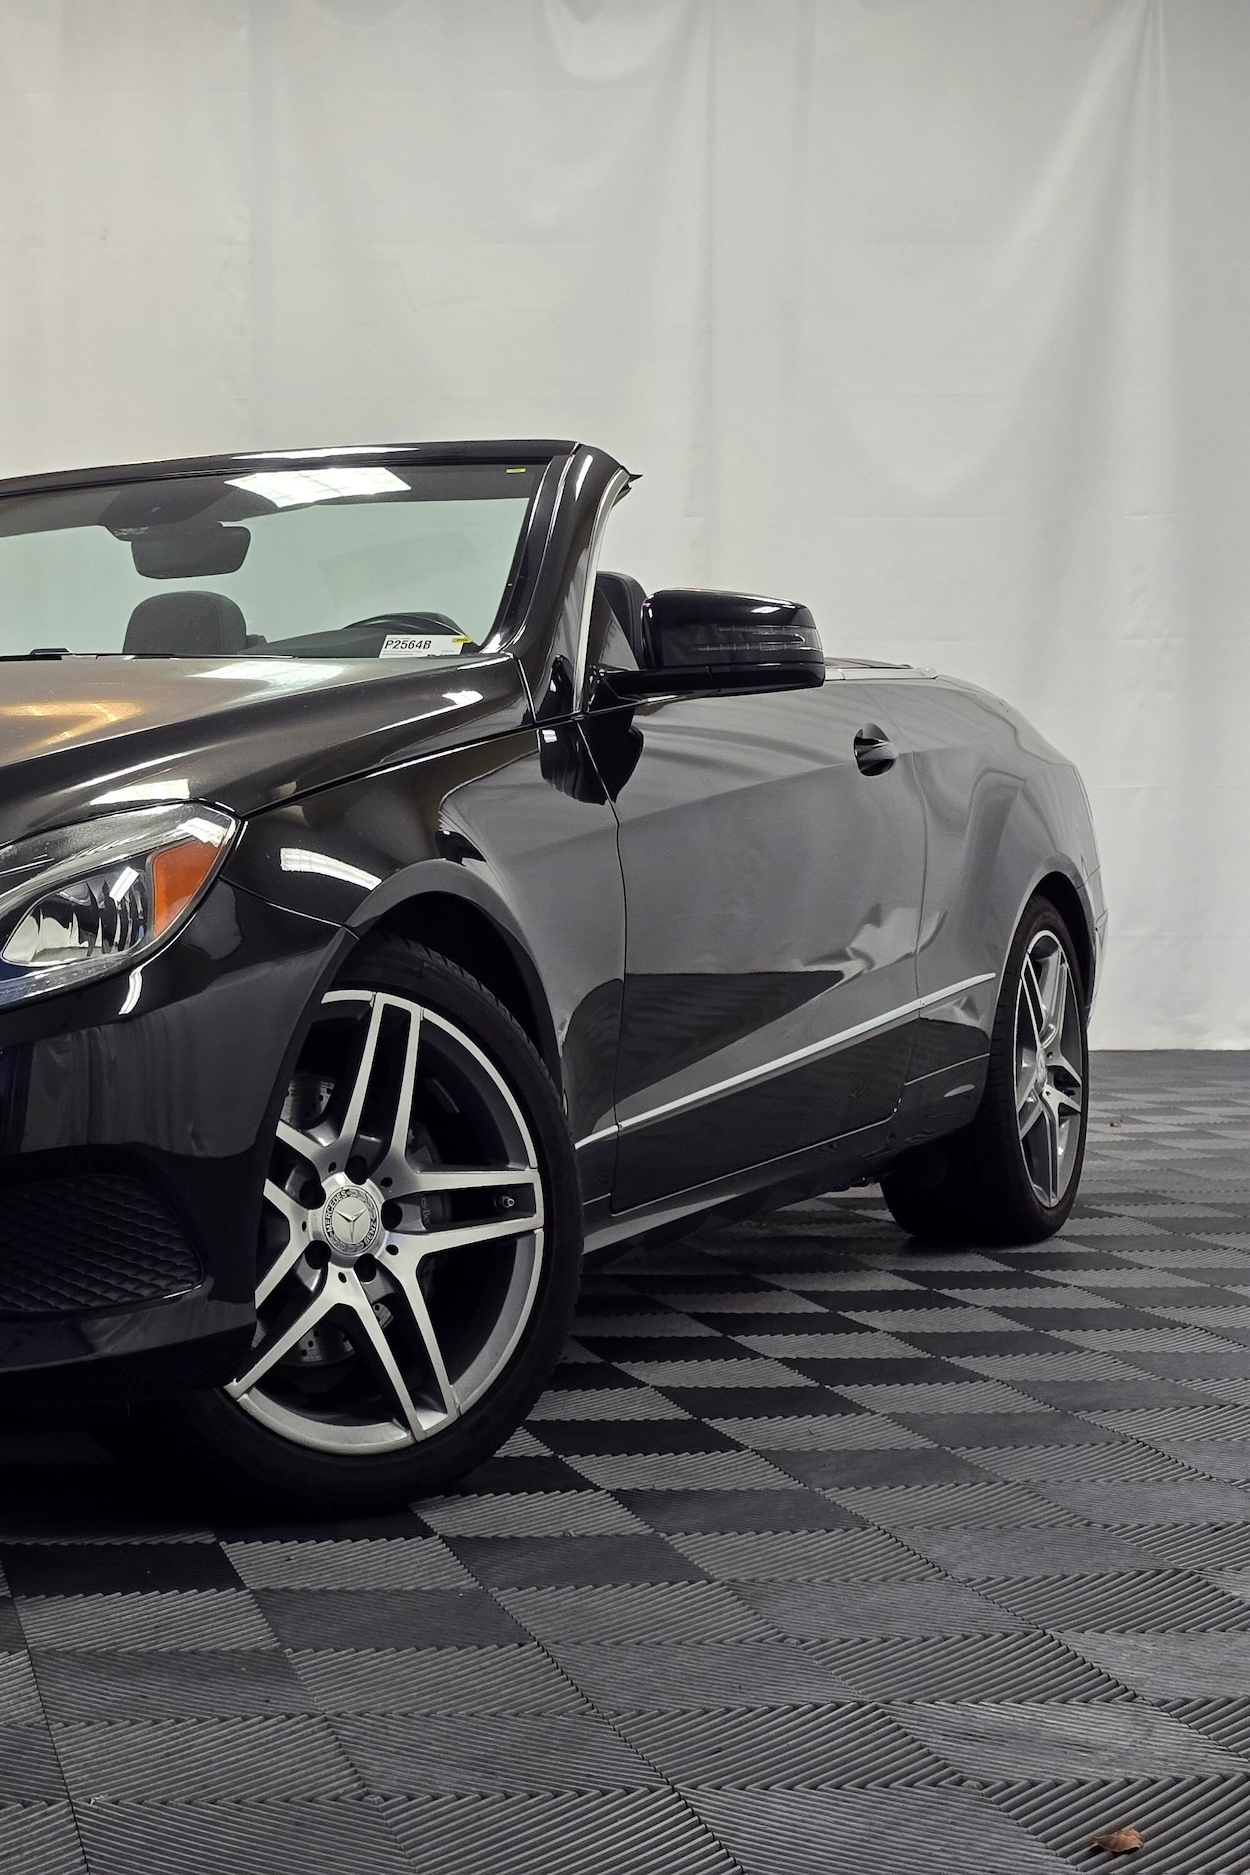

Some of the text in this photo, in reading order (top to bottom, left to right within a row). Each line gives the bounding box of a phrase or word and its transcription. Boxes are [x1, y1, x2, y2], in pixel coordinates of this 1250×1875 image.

[384, 640, 432, 650] P2564B
[325, 1190, 348, 1232] MERCEDES
[364, 1219, 377, 1245] BENZ
